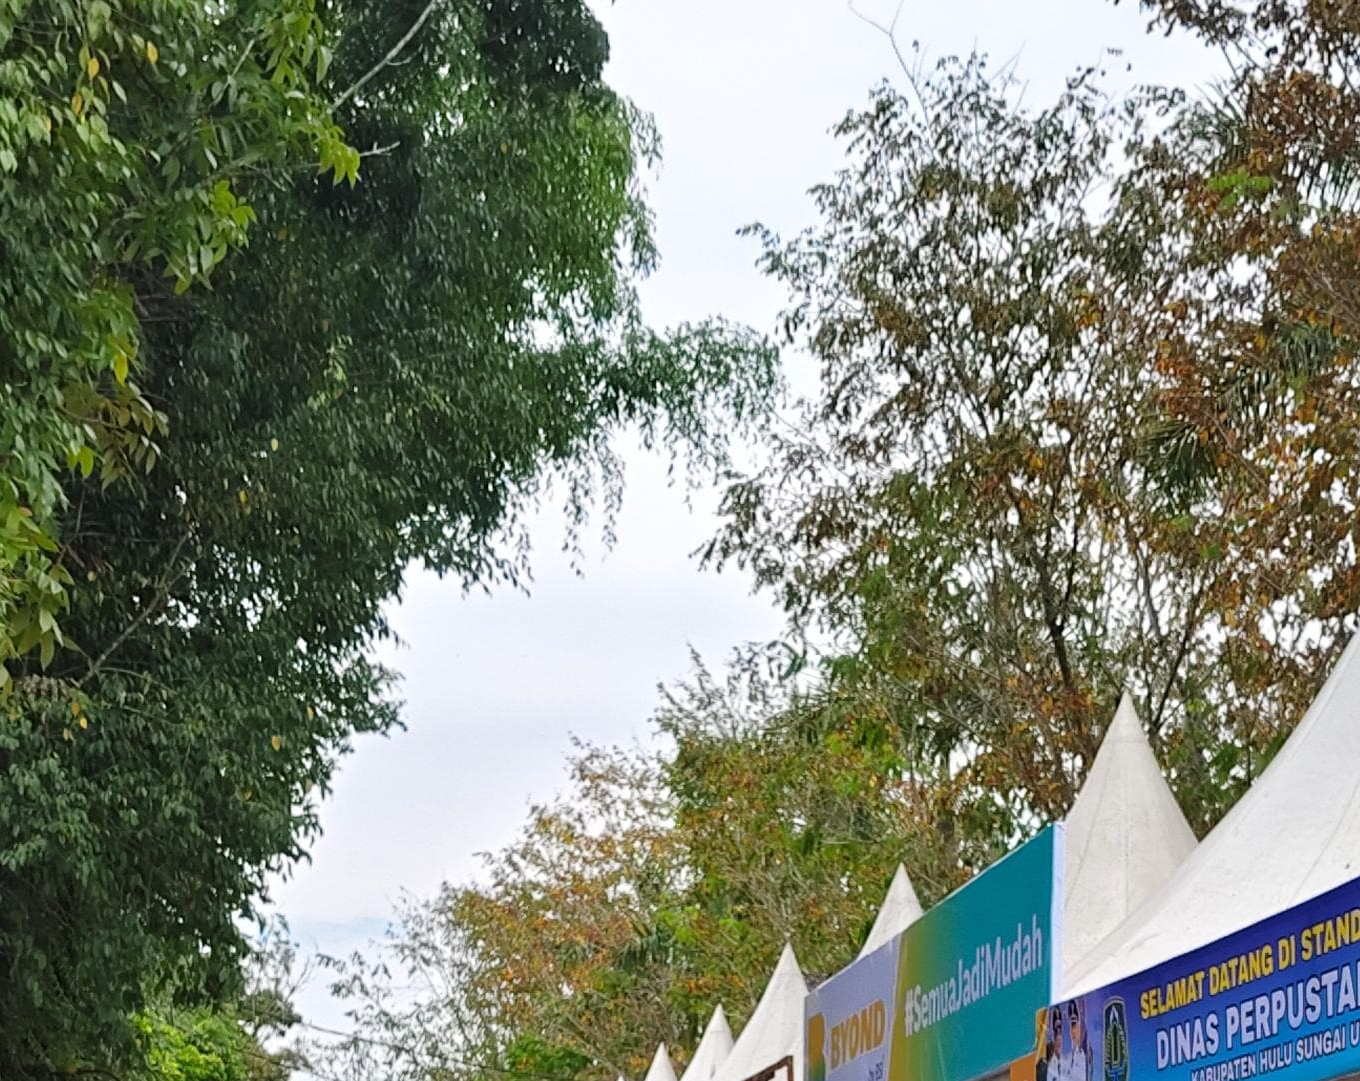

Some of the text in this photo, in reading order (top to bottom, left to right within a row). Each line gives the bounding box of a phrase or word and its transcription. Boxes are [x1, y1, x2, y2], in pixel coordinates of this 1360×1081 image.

[905, 913, 1043, 1038] #SemuaJadiMudah
[1140, 970, 1206, 1020] SELAMAT
[1209, 944, 1274, 996] DATANG
[1278, 934, 1296, 971] DI
[830, 1000, 887, 1070] BYOND
[1155, 1011, 1220, 1070] DINAS
[1259, 1046, 1293, 1075] HULU
[1295, 1026, 1347, 1062] SUNGAI
